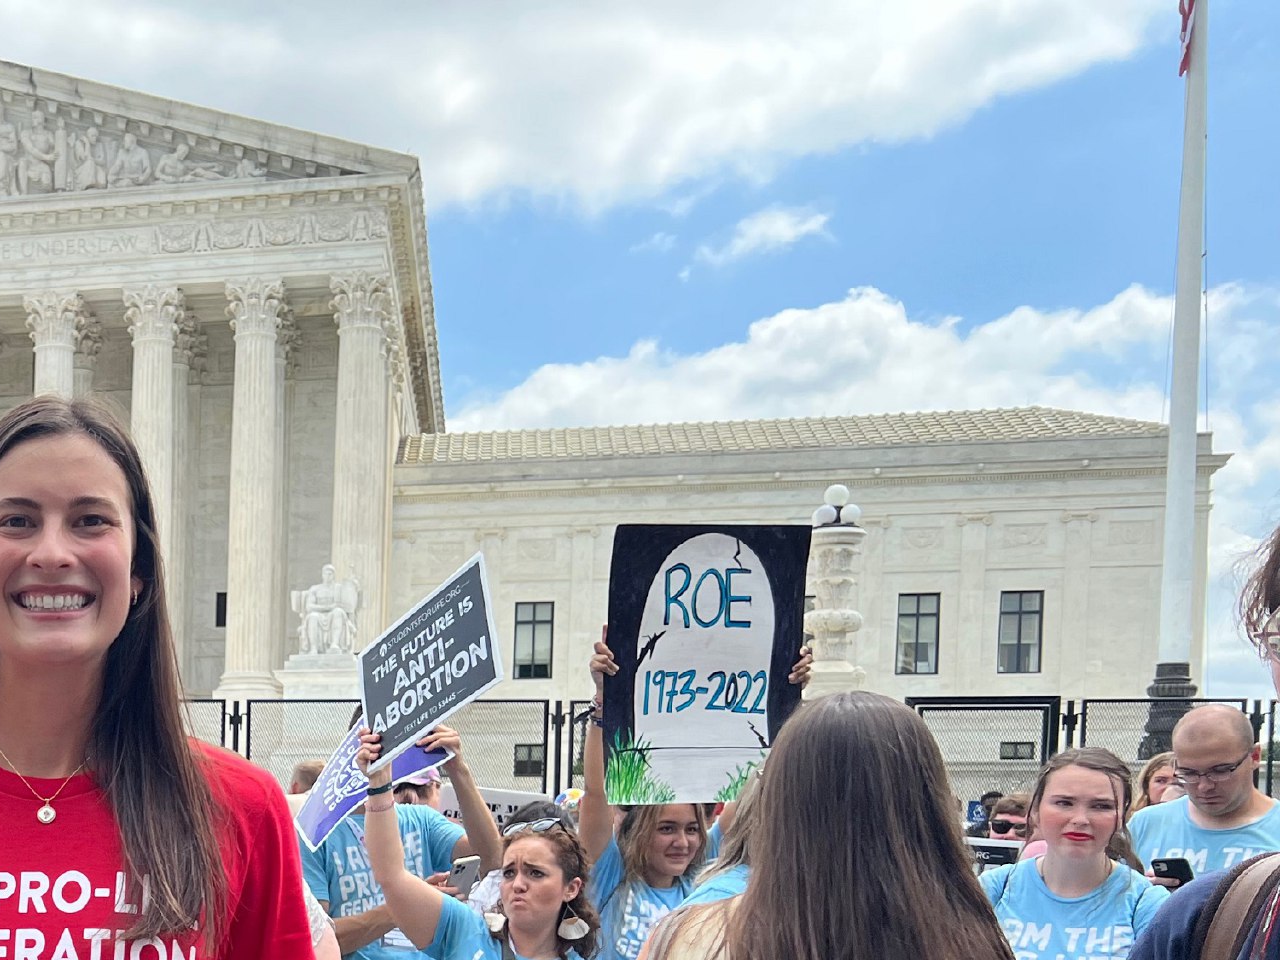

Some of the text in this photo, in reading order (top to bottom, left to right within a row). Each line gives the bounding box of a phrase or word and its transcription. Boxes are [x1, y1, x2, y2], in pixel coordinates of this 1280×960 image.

[20, 238, 89, 258] UNDER
[95, 235, 139, 253] LAW
[663, 562, 752, 628] ROE
[372, 596, 473, 683] THE FUTURE IS
[393, 637, 454, 696] ANTI-
[372, 635, 488, 735] ABORTION
[642, 669, 767, 715] 1973-2022
[1064, 925, 1135, 954] THE
